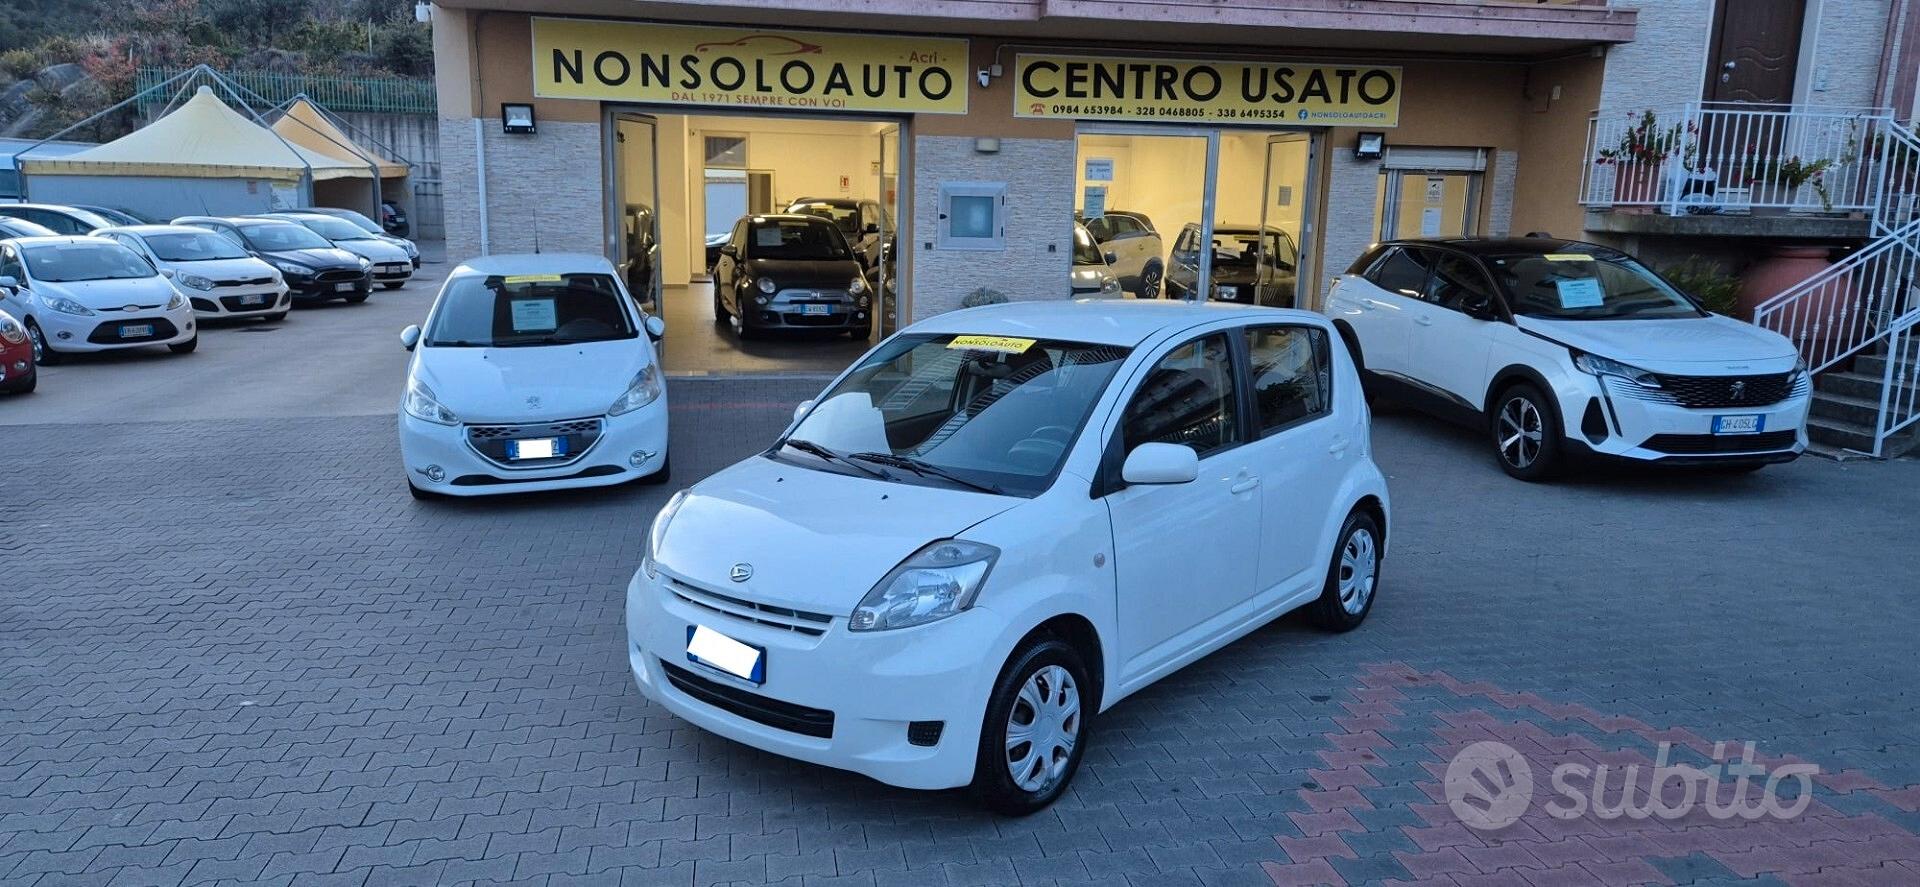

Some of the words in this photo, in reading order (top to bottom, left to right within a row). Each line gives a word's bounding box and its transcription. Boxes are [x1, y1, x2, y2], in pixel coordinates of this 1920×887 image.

[908, 50, 938, 64] Acri
[552, 48, 952, 101] NONSOLOAUTO
[1022, 61, 1222, 102] CENTRO
[1241, 67, 1396, 106] USATO
[671, 91, 697, 102] DAL
[702, 93, 730, 103] 1971
[735, 94, 784, 105] SEMPRE
[788, 96, 818, 107] CON
[823, 98, 847, 108] VOI
[1052, 104, 1080, 115] 0984
[1083, 105, 1124, 116] 653984
[1136, 106, 1156, 116] 328
[1158, 107, 1205, 118] 0468805
[1217, 108, 1236, 118] 338
[1239, 108, 1286, 119] 6495354
[1310, 111, 1387, 120] NONSOLOAUTOACRI
[953, 339, 1024, 349] NONSOLOAUTO
